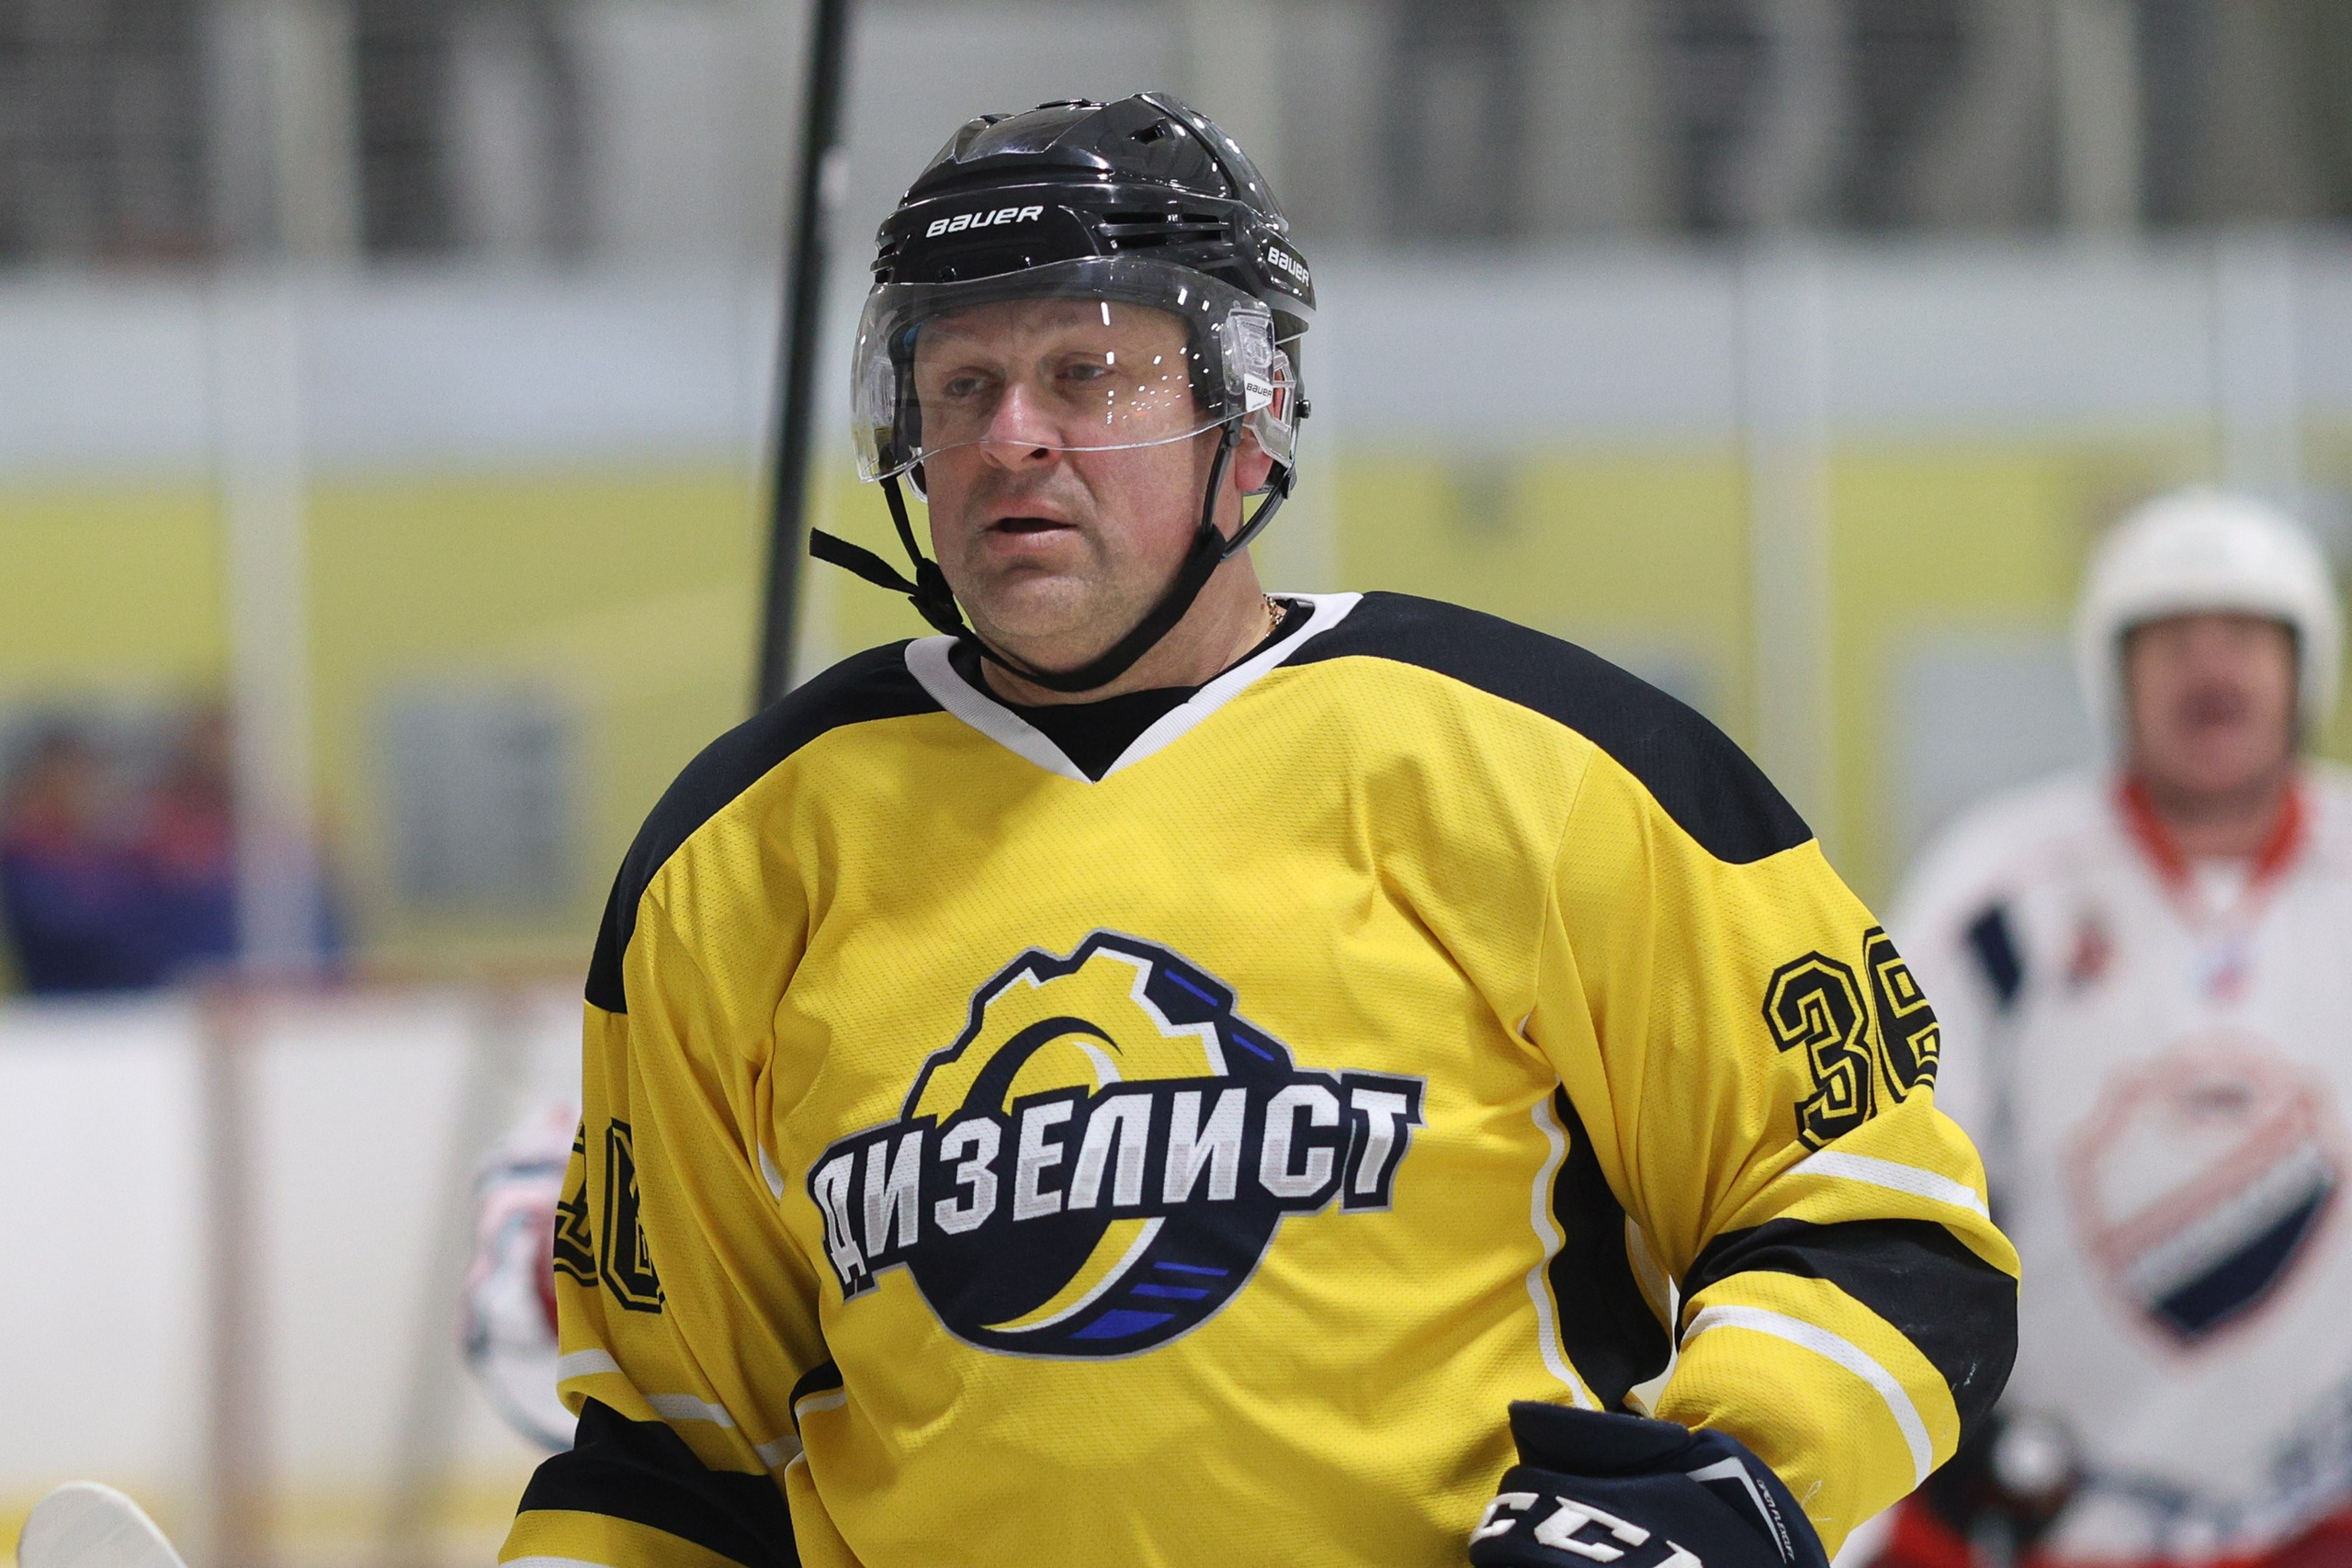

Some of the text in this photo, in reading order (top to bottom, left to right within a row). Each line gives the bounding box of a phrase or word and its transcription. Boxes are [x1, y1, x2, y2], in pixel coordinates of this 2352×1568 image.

[925, 205, 1045, 238] BAUER
[1268, 245, 1310, 288] BAUER
[1246, 382, 1272, 398] BAUER
[1760, 925, 1941, 1153] 36
[813, 1084, 1408, 1286] ДИЗЕЛИСТ
